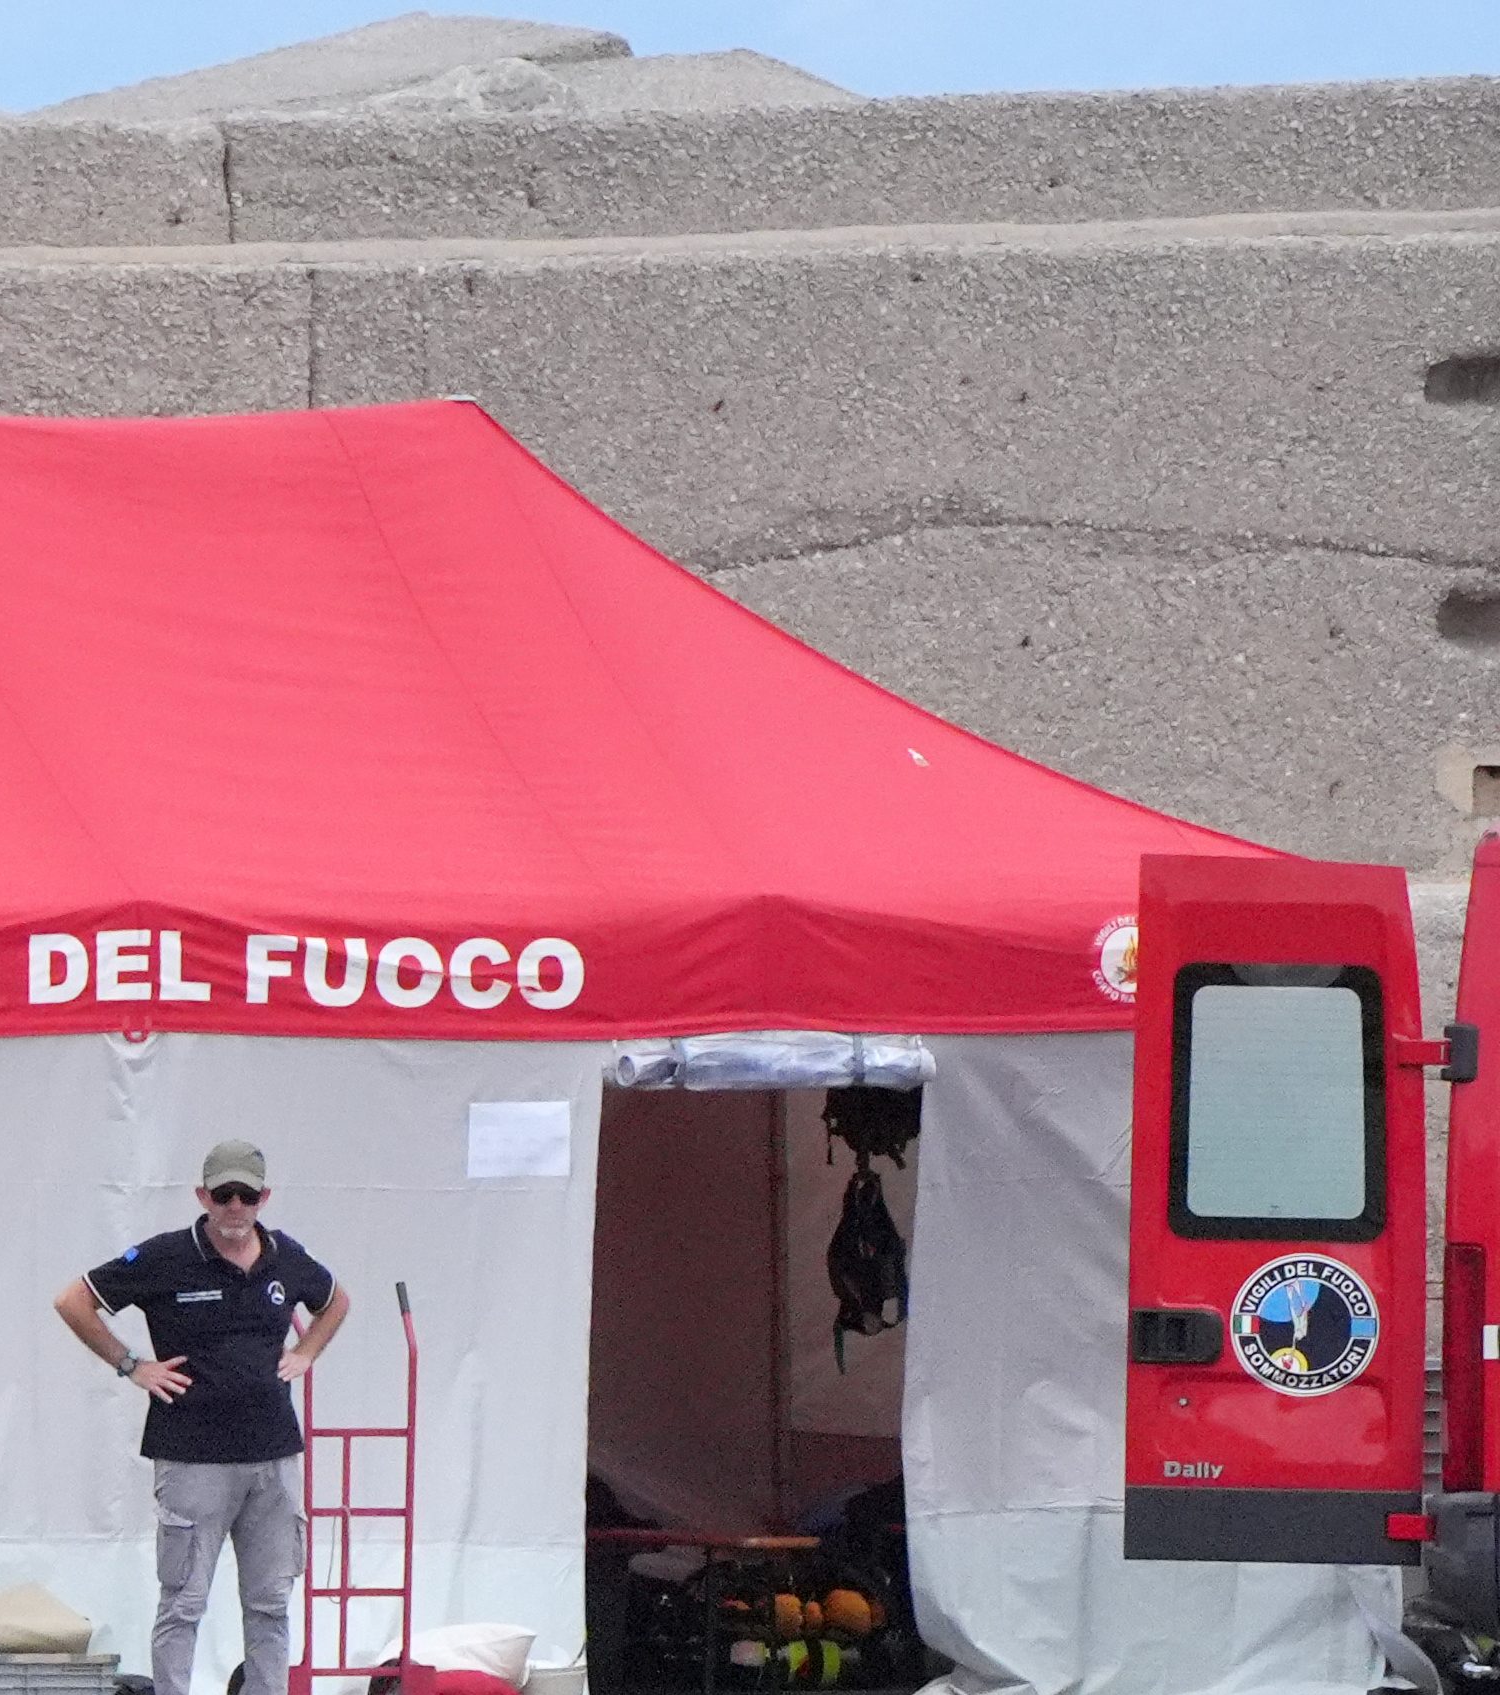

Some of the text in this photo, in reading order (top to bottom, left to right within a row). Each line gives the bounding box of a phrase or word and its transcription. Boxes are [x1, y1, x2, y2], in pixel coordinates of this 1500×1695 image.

[28, 930, 211, 1005] DEL
[245, 935, 585, 1010] FUOCO
[1242, 1262, 1369, 1315] VIGILI DEL FUOCO
[1244, 1345, 1365, 1388] SOMMOZZATORI
